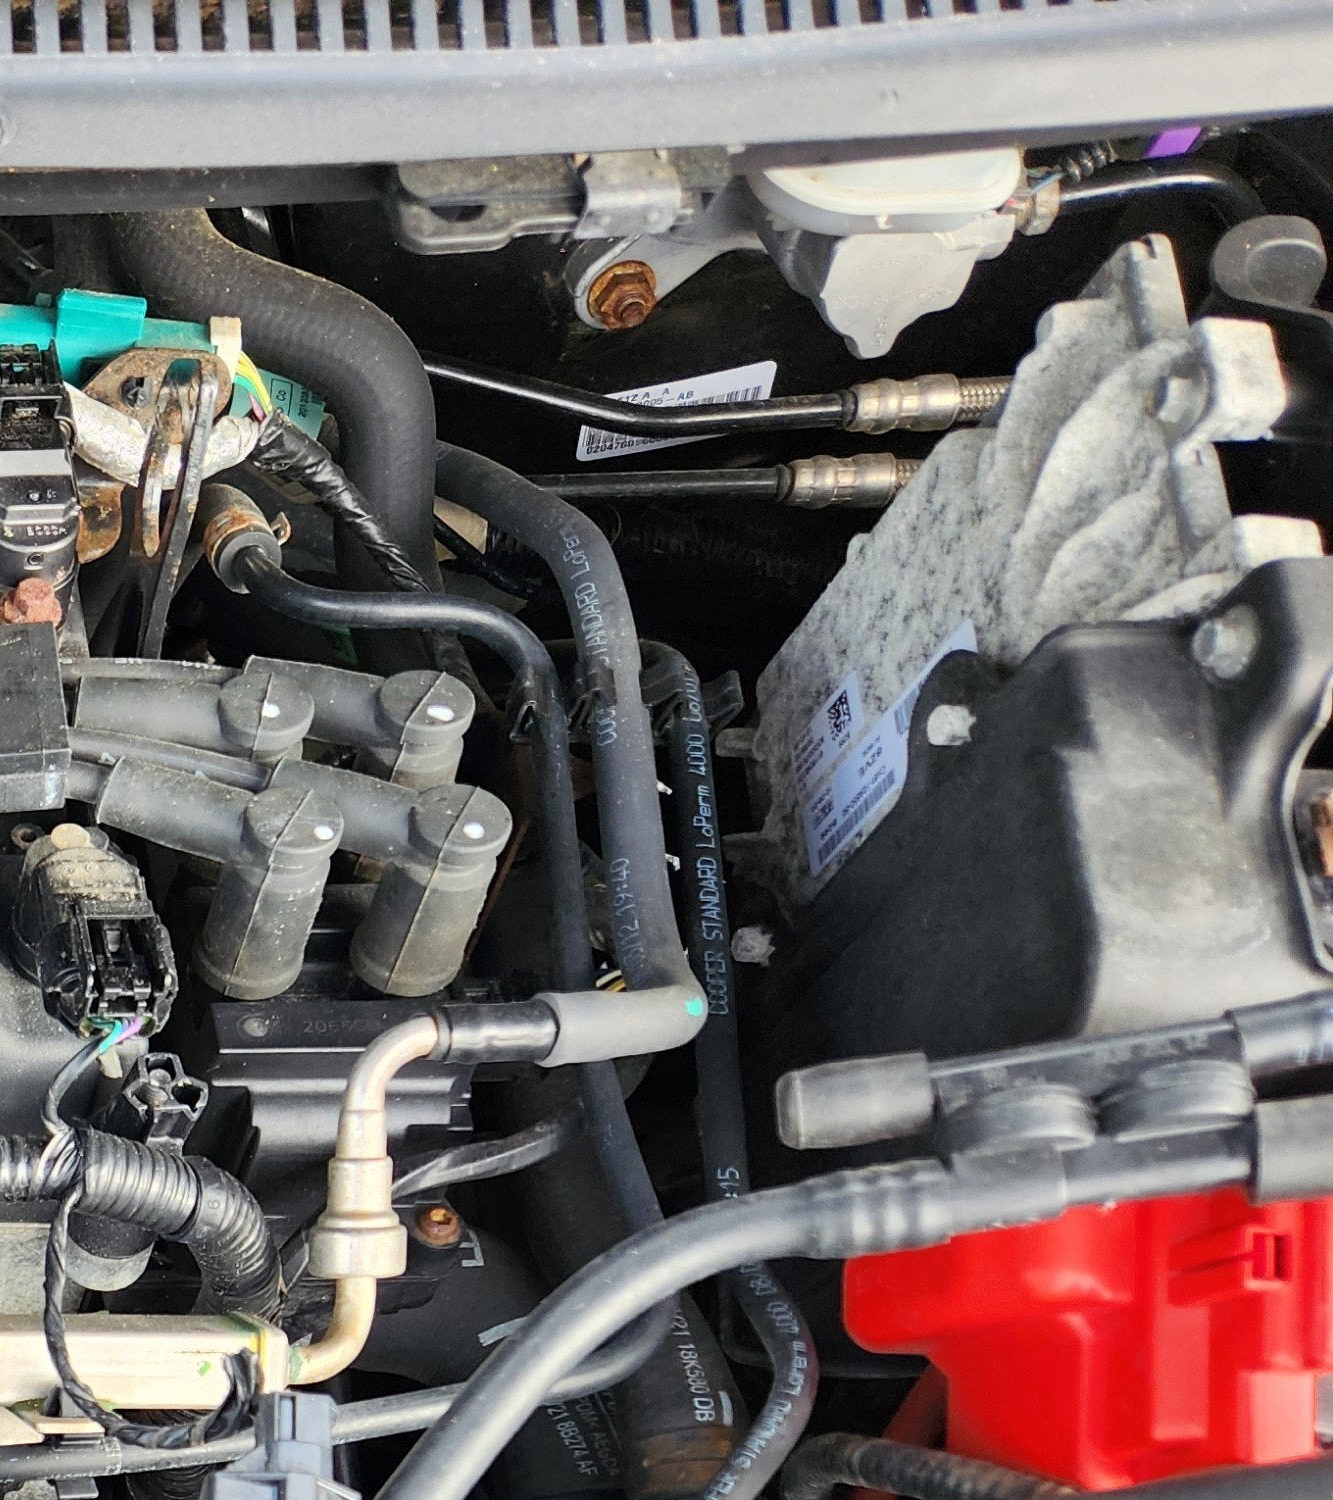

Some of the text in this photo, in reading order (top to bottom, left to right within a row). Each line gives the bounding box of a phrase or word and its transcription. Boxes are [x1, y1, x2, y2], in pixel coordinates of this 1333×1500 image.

[693, 785, 717, 849] LoPerm
[696, 856, 724, 941] STANDARD
[704, 950, 730, 1016] COOPER
[692, 1396, 716, 1423] DB
[576, 1460, 599, 1476] AF
